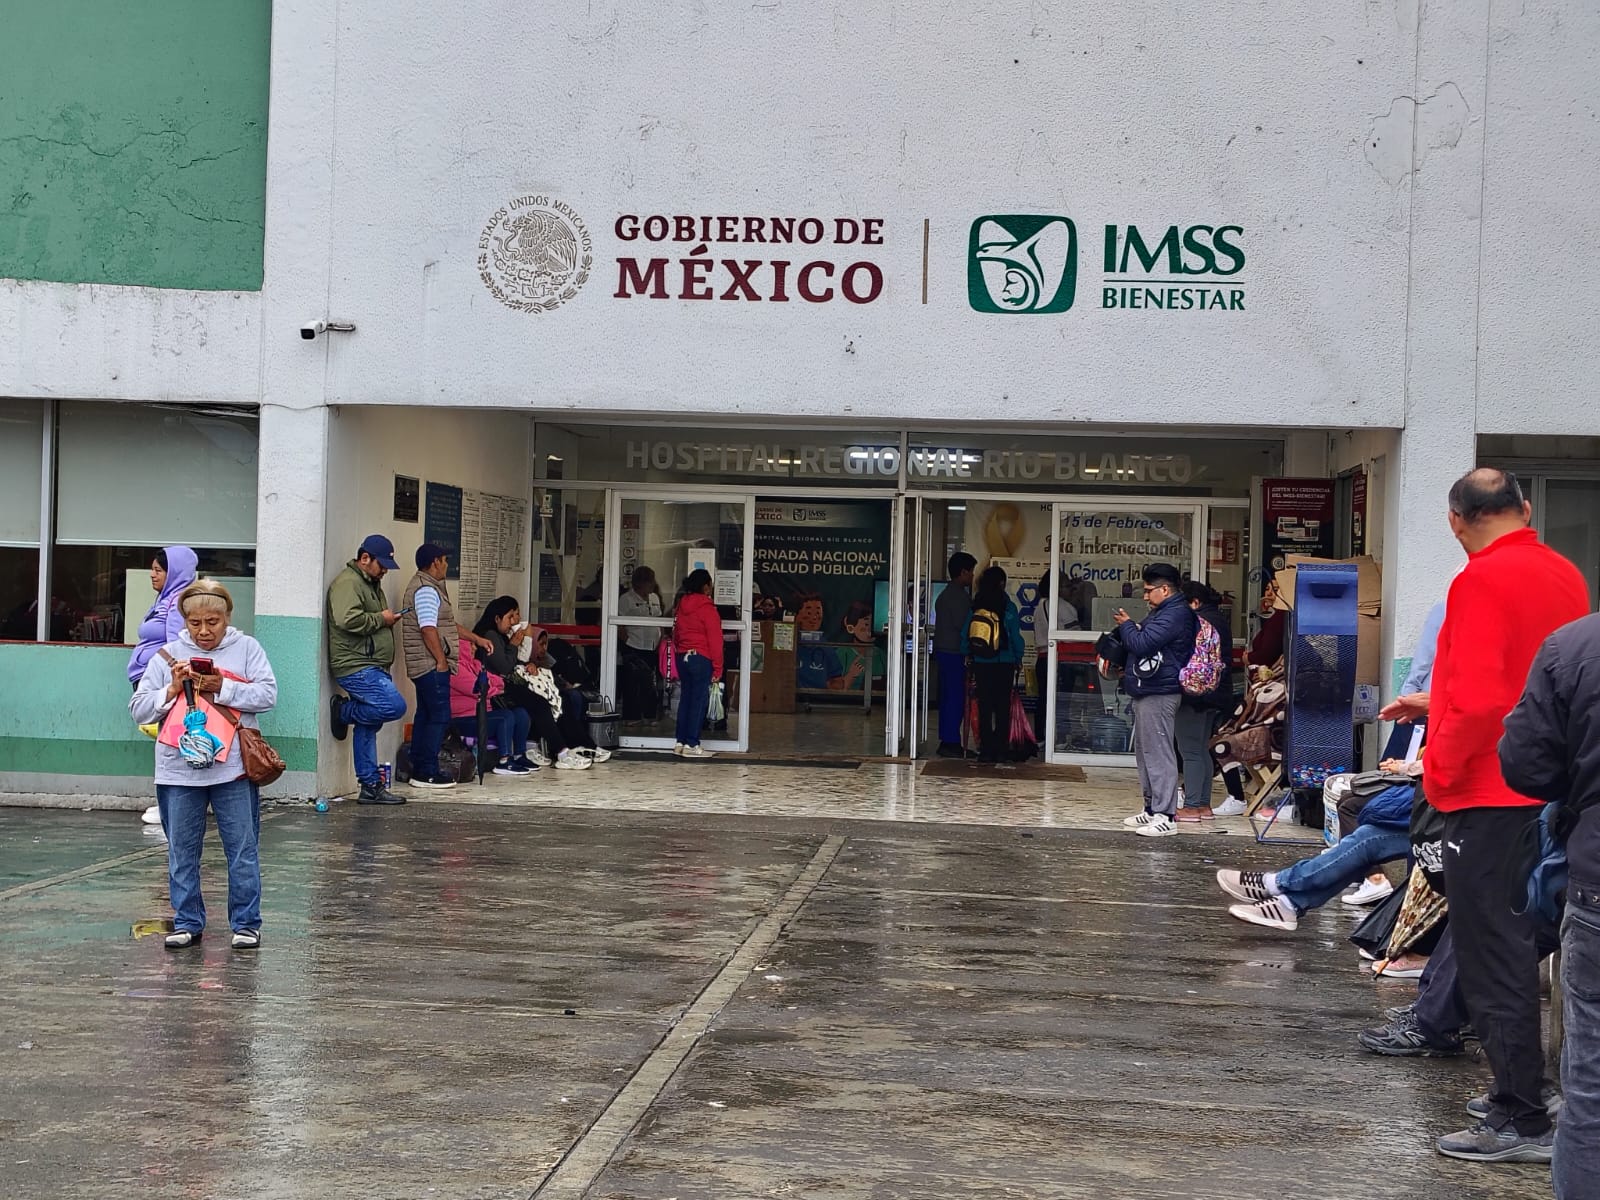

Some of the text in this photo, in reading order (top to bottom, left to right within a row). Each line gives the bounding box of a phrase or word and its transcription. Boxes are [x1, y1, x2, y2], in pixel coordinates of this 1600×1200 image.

[479, 195, 593, 252] ESTADOS UNIDOS MEXICANOS
[614, 214, 884, 245] GOBIERNO DE
[1103, 224, 1246, 276] IMSS
[613, 243, 884, 304] MÉXICO
[1102, 287, 1246, 311] BIENESTAR
[626, 440, 1192, 483] HOSPITAL REGIONAL RÍO BLANCO
[1084, 515, 1103, 528] de
[1106, 515, 1165, 530] Febrero
[812, 550, 887, 564] NACIONAL
[1079, 535, 1184, 557] Internacional
[761, 561, 810, 575] SALUD
[1069, 562, 1125, 583] Cáncer
